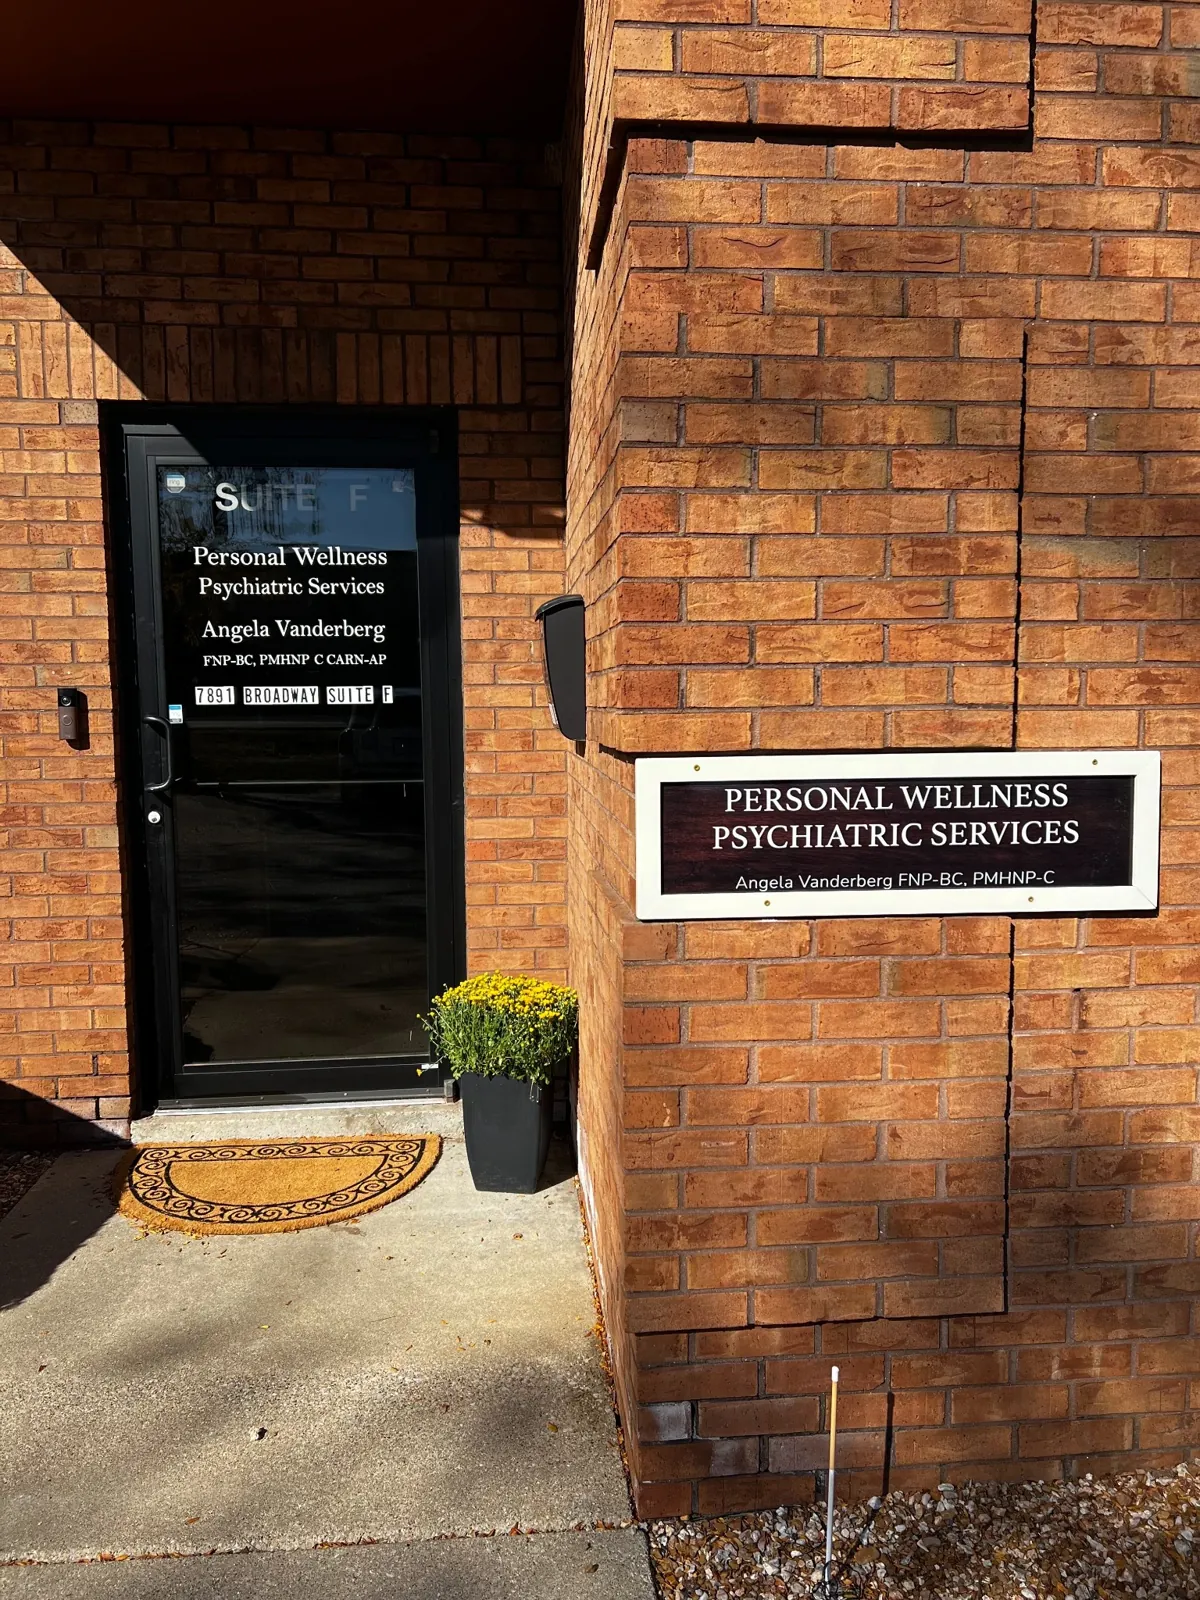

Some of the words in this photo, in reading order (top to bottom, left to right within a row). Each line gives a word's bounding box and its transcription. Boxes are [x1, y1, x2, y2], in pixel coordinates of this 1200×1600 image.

[215, 482, 316, 512] SUITE
[350, 484, 370, 512] F
[193, 546, 286, 566] Personal
[292, 546, 388, 566] Wellness
[199, 577, 303, 600] Psychiatric
[308, 577, 385, 595] Services
[202, 619, 270, 643] Angela
[275, 619, 386, 643] Vanderberg
[203, 654, 257, 667] FNP-BC,
[259, 654, 310, 666] PMHNP
[314, 654, 324, 666] C
[326, 654, 387, 666] CARN-AP
[196, 687, 233, 703] 7891
[245, 687, 318, 703] BROADWAY
[328, 686, 373, 703] SUITE
[383, 686, 392, 702] F
[724, 786, 893, 812] PERSONAL
[899, 783, 1069, 810] WELLNESS
[712, 823, 922, 849] PSYCHIATRIC
[930, 820, 1080, 846] SERVICES
[735, 876, 793, 891] Angela
[799, 873, 893, 890] Vanderberg
[898, 872, 967, 887] FNP-BC,
[973, 870, 1055, 885] PMHNP-C
